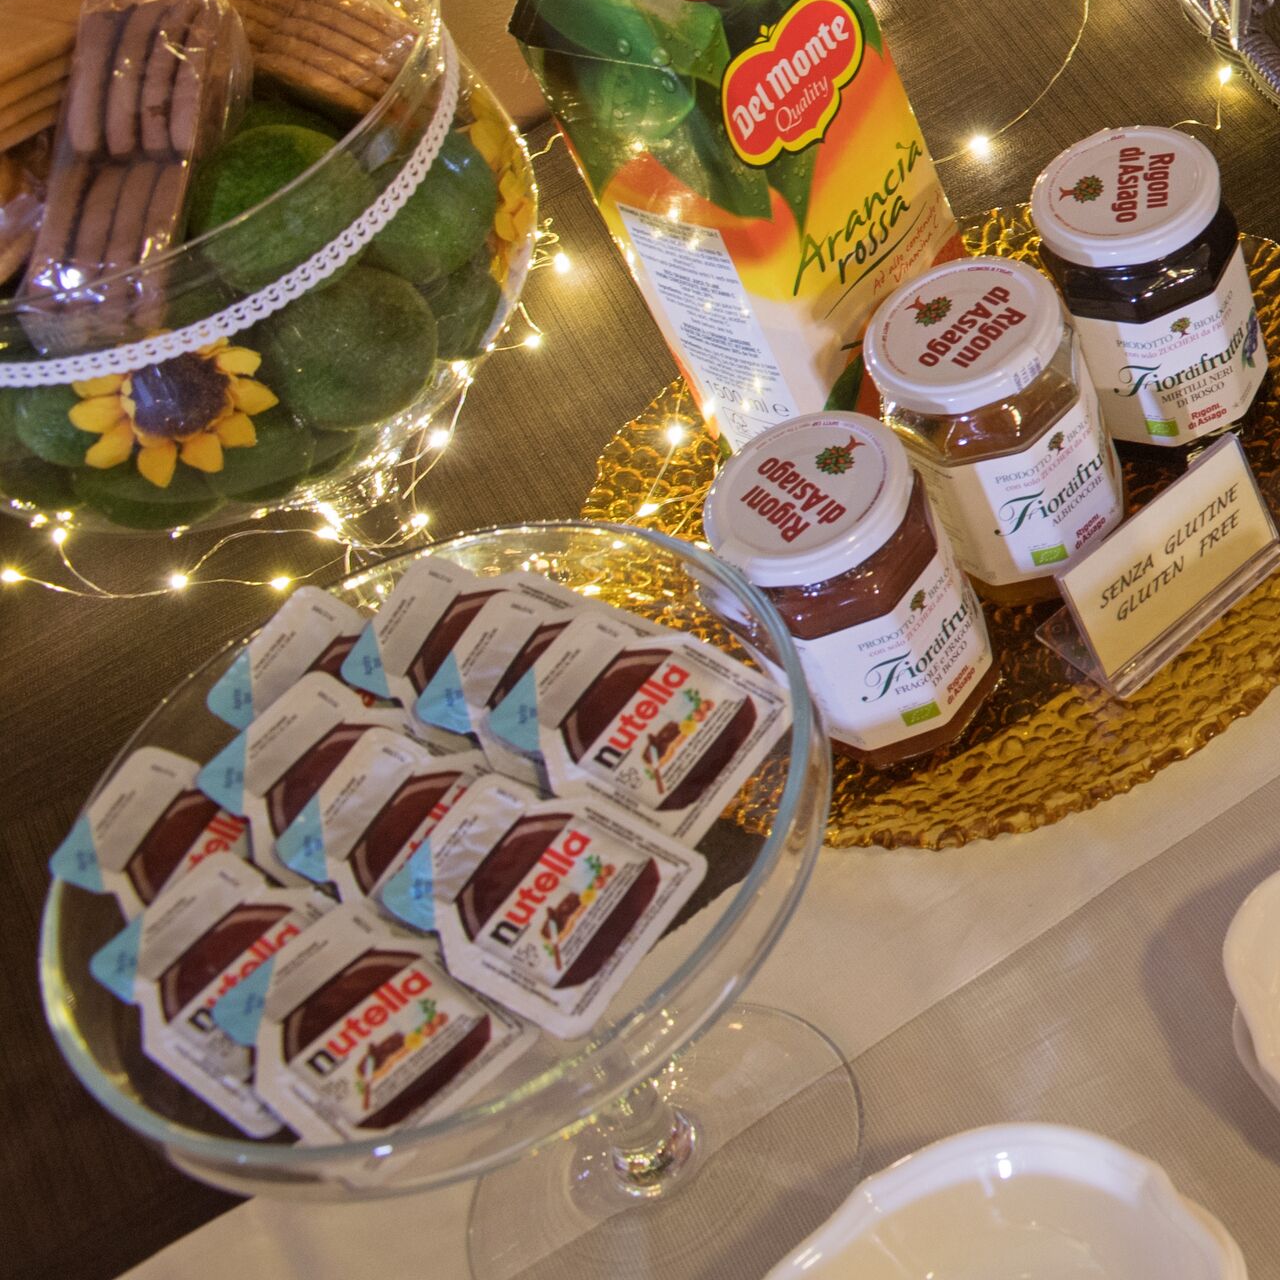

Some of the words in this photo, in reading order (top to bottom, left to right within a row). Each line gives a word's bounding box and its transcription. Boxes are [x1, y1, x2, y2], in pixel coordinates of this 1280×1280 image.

[732, 82, 775, 140] Del
[766, 15, 849, 100] Monte
[775, 76, 829, 132] Quality
[1119, 147, 1145, 162] di
[1143, 152, 1175, 209] Rigoni
[793, 140, 922, 296] Arancia
[1111, 164, 1144, 223] Asiago
[838, 195, 910, 285] rossa
[982, 286, 1011, 306] di
[918, 302, 993, 367] Asiago
[951, 306, 1027, 369] Rigoni
[1113, 327, 1244, 397] Fiordifrutta
[1116, 333, 1173, 348] PRODOTTO
[1158, 335, 1200, 356] ZUCCHERI
[1161, 377, 1208, 404] MIRTILLI
[1209, 365, 1233, 382] NERI
[1176, 399, 1189, 408] DI
[1191, 381, 1225, 402] BOSCO
[1191, 402, 1220, 420] Rigoni
[1188, 421, 1197, 430] di
[1198, 408, 1227, 426] Asiago
[757, 457, 830, 512] Asiago
[994, 453, 1104, 537] Fiordifru
[995, 454, 1052, 485] PRODOTTO
[740, 485, 811, 543] Rigoni
[815, 499, 847, 525] di
[1052, 473, 1104, 527] ALBICOCCHE
[1075, 513, 1100, 539] Rigoni
[1075, 539, 1083, 550] di
[1082, 517, 1106, 545] Asiago
[1100, 553, 1155, 609] SENZA
[1164, 482, 1240, 556] GLUTINE
[1116, 555, 1185, 621] GLUTEN
[1199, 508, 1240, 557] FREE
[857, 613, 916, 652] PRODOTTO
[861, 603, 968, 702] Fiordifru
[894, 662, 941, 696] FRAGOLE
[931, 675, 943, 687] DI
[942, 640, 968, 675] BOSCO
[593, 663, 691, 769] nutella
[490, 830, 592, 946] nutella
[306, 970, 432, 1077] nutella
